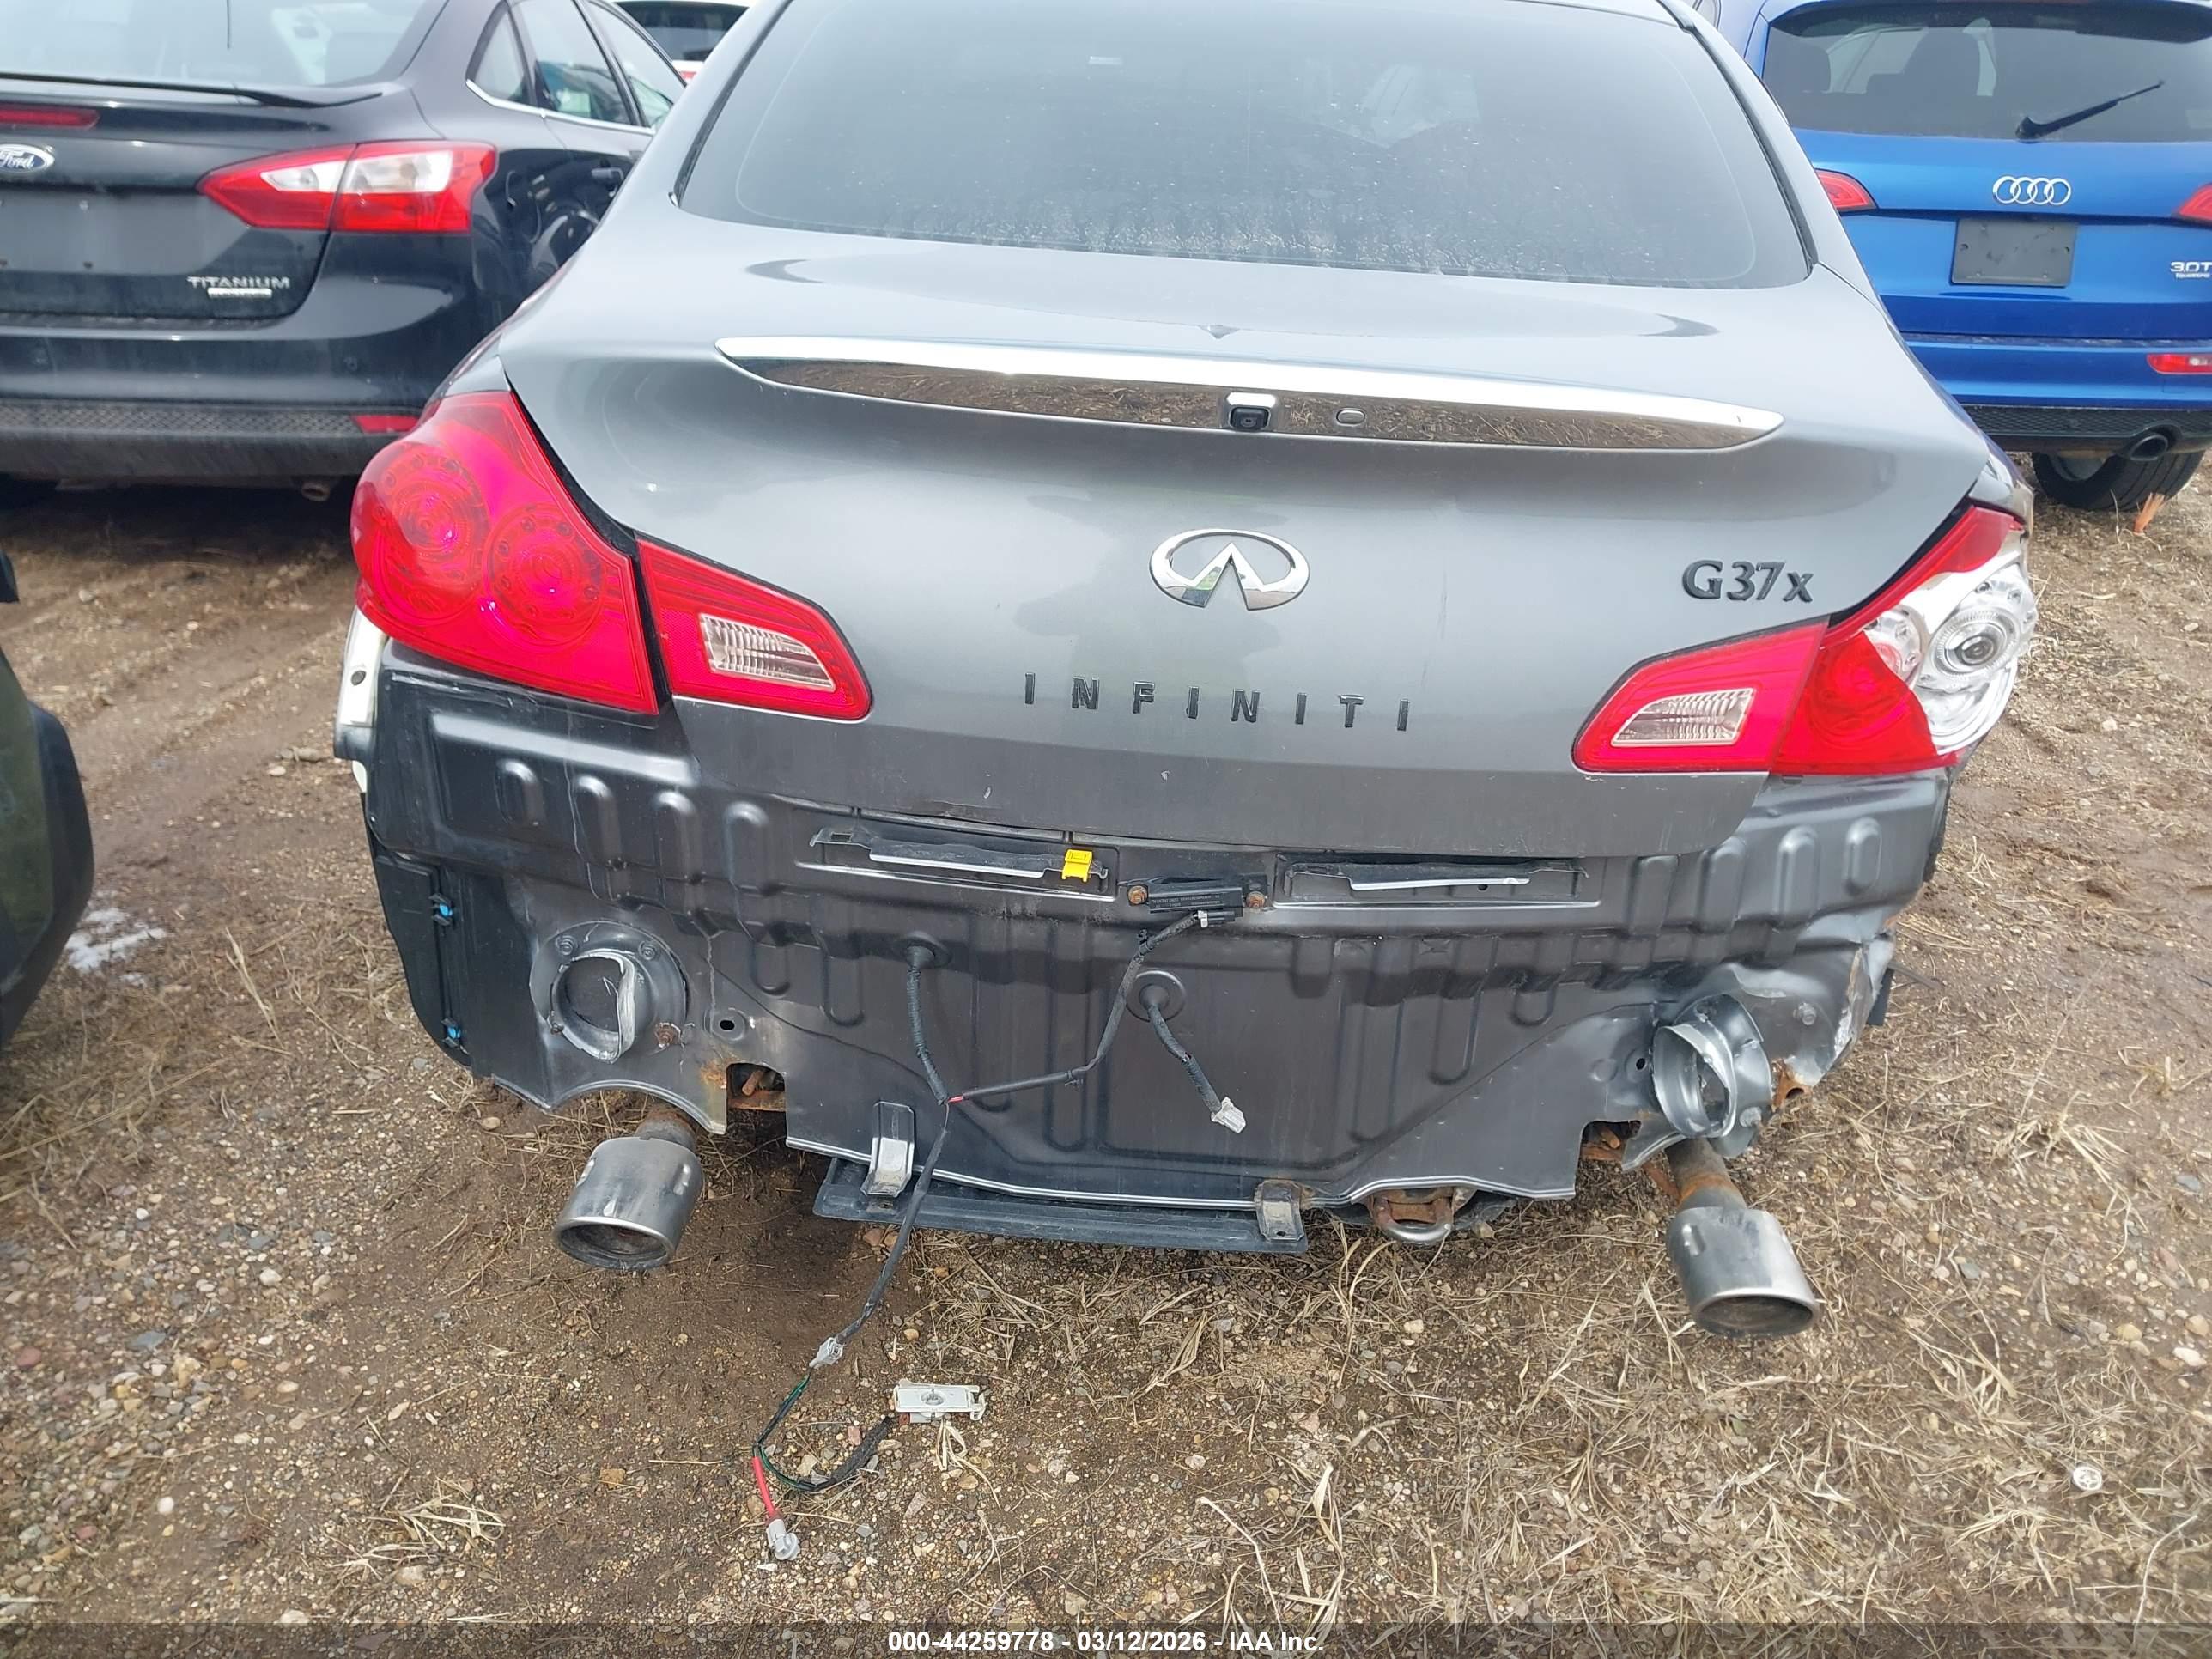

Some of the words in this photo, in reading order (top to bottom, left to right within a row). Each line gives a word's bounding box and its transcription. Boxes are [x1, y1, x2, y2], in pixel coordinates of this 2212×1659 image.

[186, 276, 290, 289] TITANIUM
[1682, 560, 1814, 603] G37x
[1024, 672, 1410, 732] INFINITI
